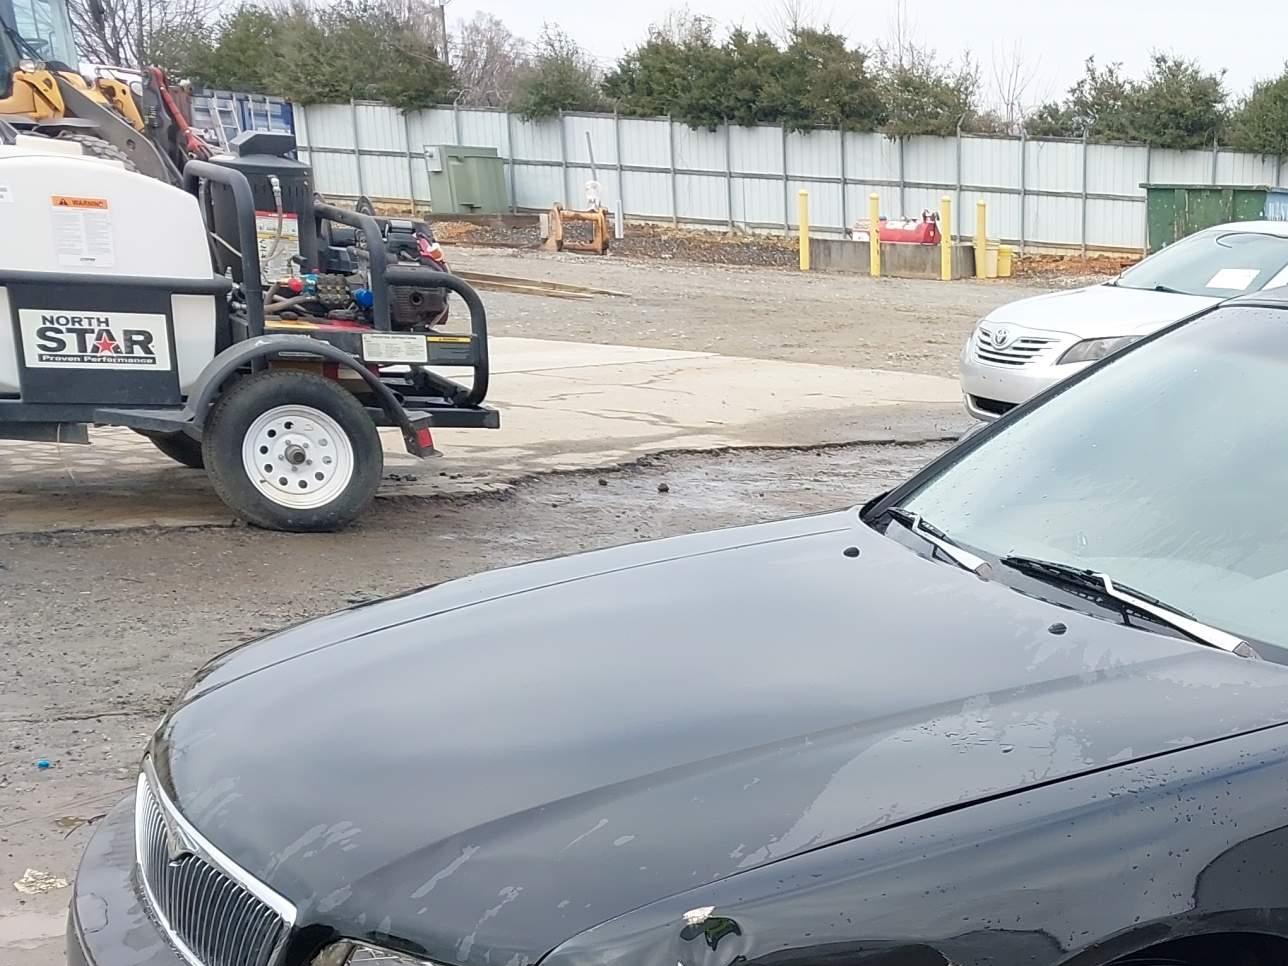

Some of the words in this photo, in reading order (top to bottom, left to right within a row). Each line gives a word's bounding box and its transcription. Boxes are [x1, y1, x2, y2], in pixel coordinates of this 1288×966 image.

[42, 315, 110, 327] NORTH
[36, 326, 155, 355] STAR
[42, 354, 81, 363] Proven
[84, 355, 154, 364] Performance
